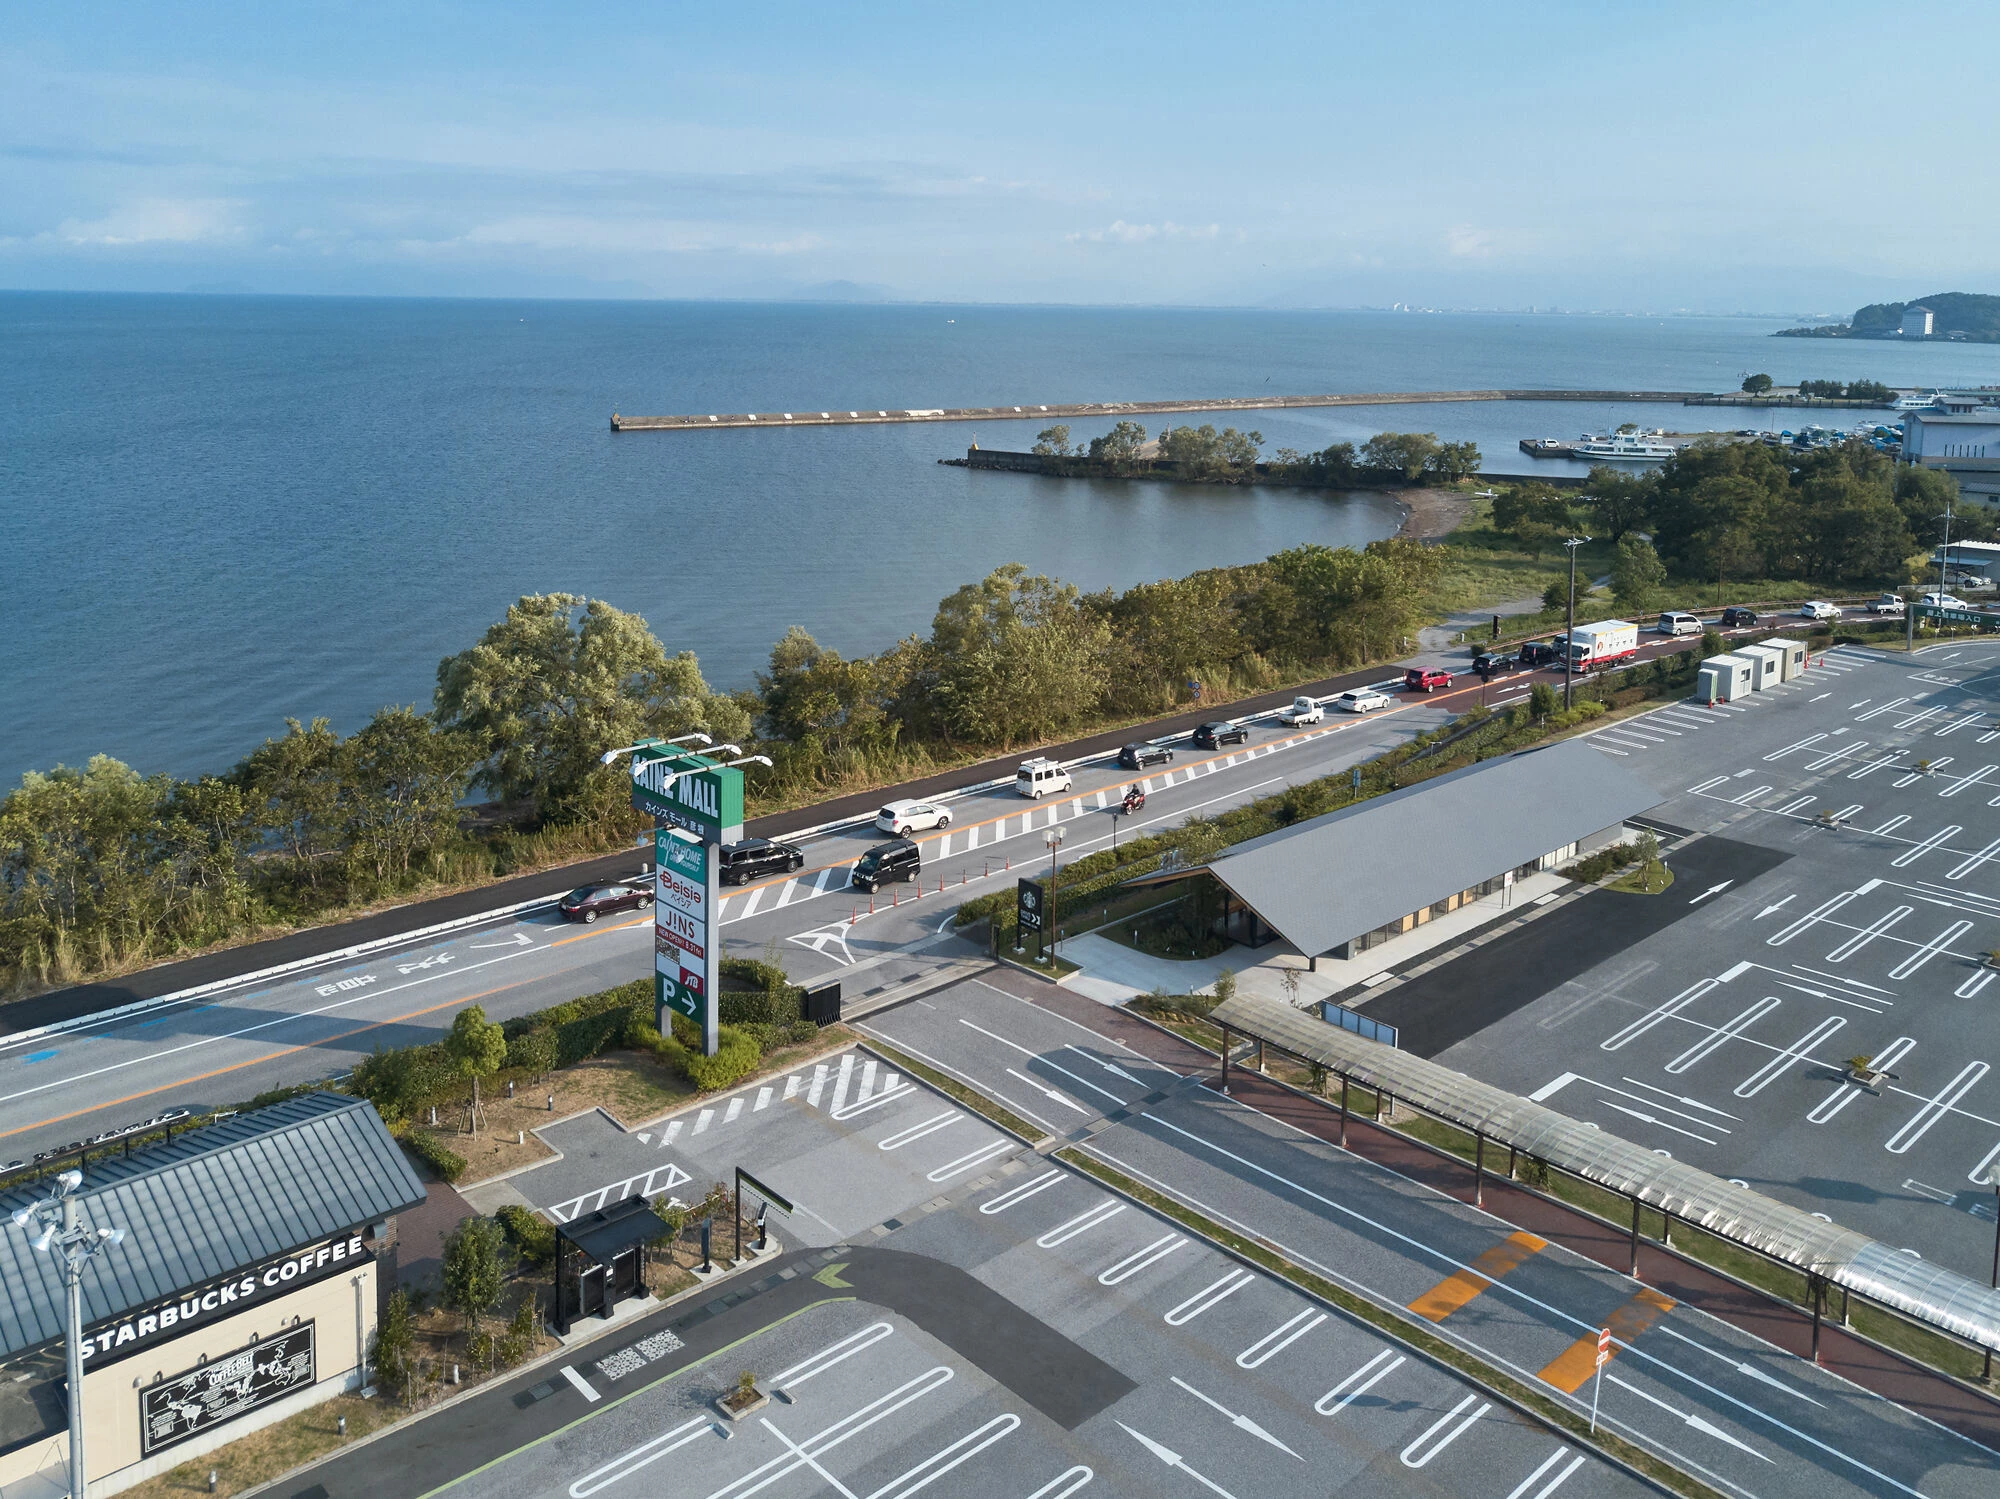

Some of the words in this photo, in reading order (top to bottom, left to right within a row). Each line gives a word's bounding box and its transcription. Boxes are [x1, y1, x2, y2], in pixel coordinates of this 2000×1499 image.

[678, 774, 719, 819] MALL
[680, 847, 703, 866] HOME
[659, 870, 702, 904] Beisia
[670, 893, 692, 909] ベイシア
[663, 977, 676, 1002] P
[684, 974, 699, 989] JTB
[80, 1276, 257, 1361] STARBUCKS
[262, 1236, 363, 1288] COFFEE
